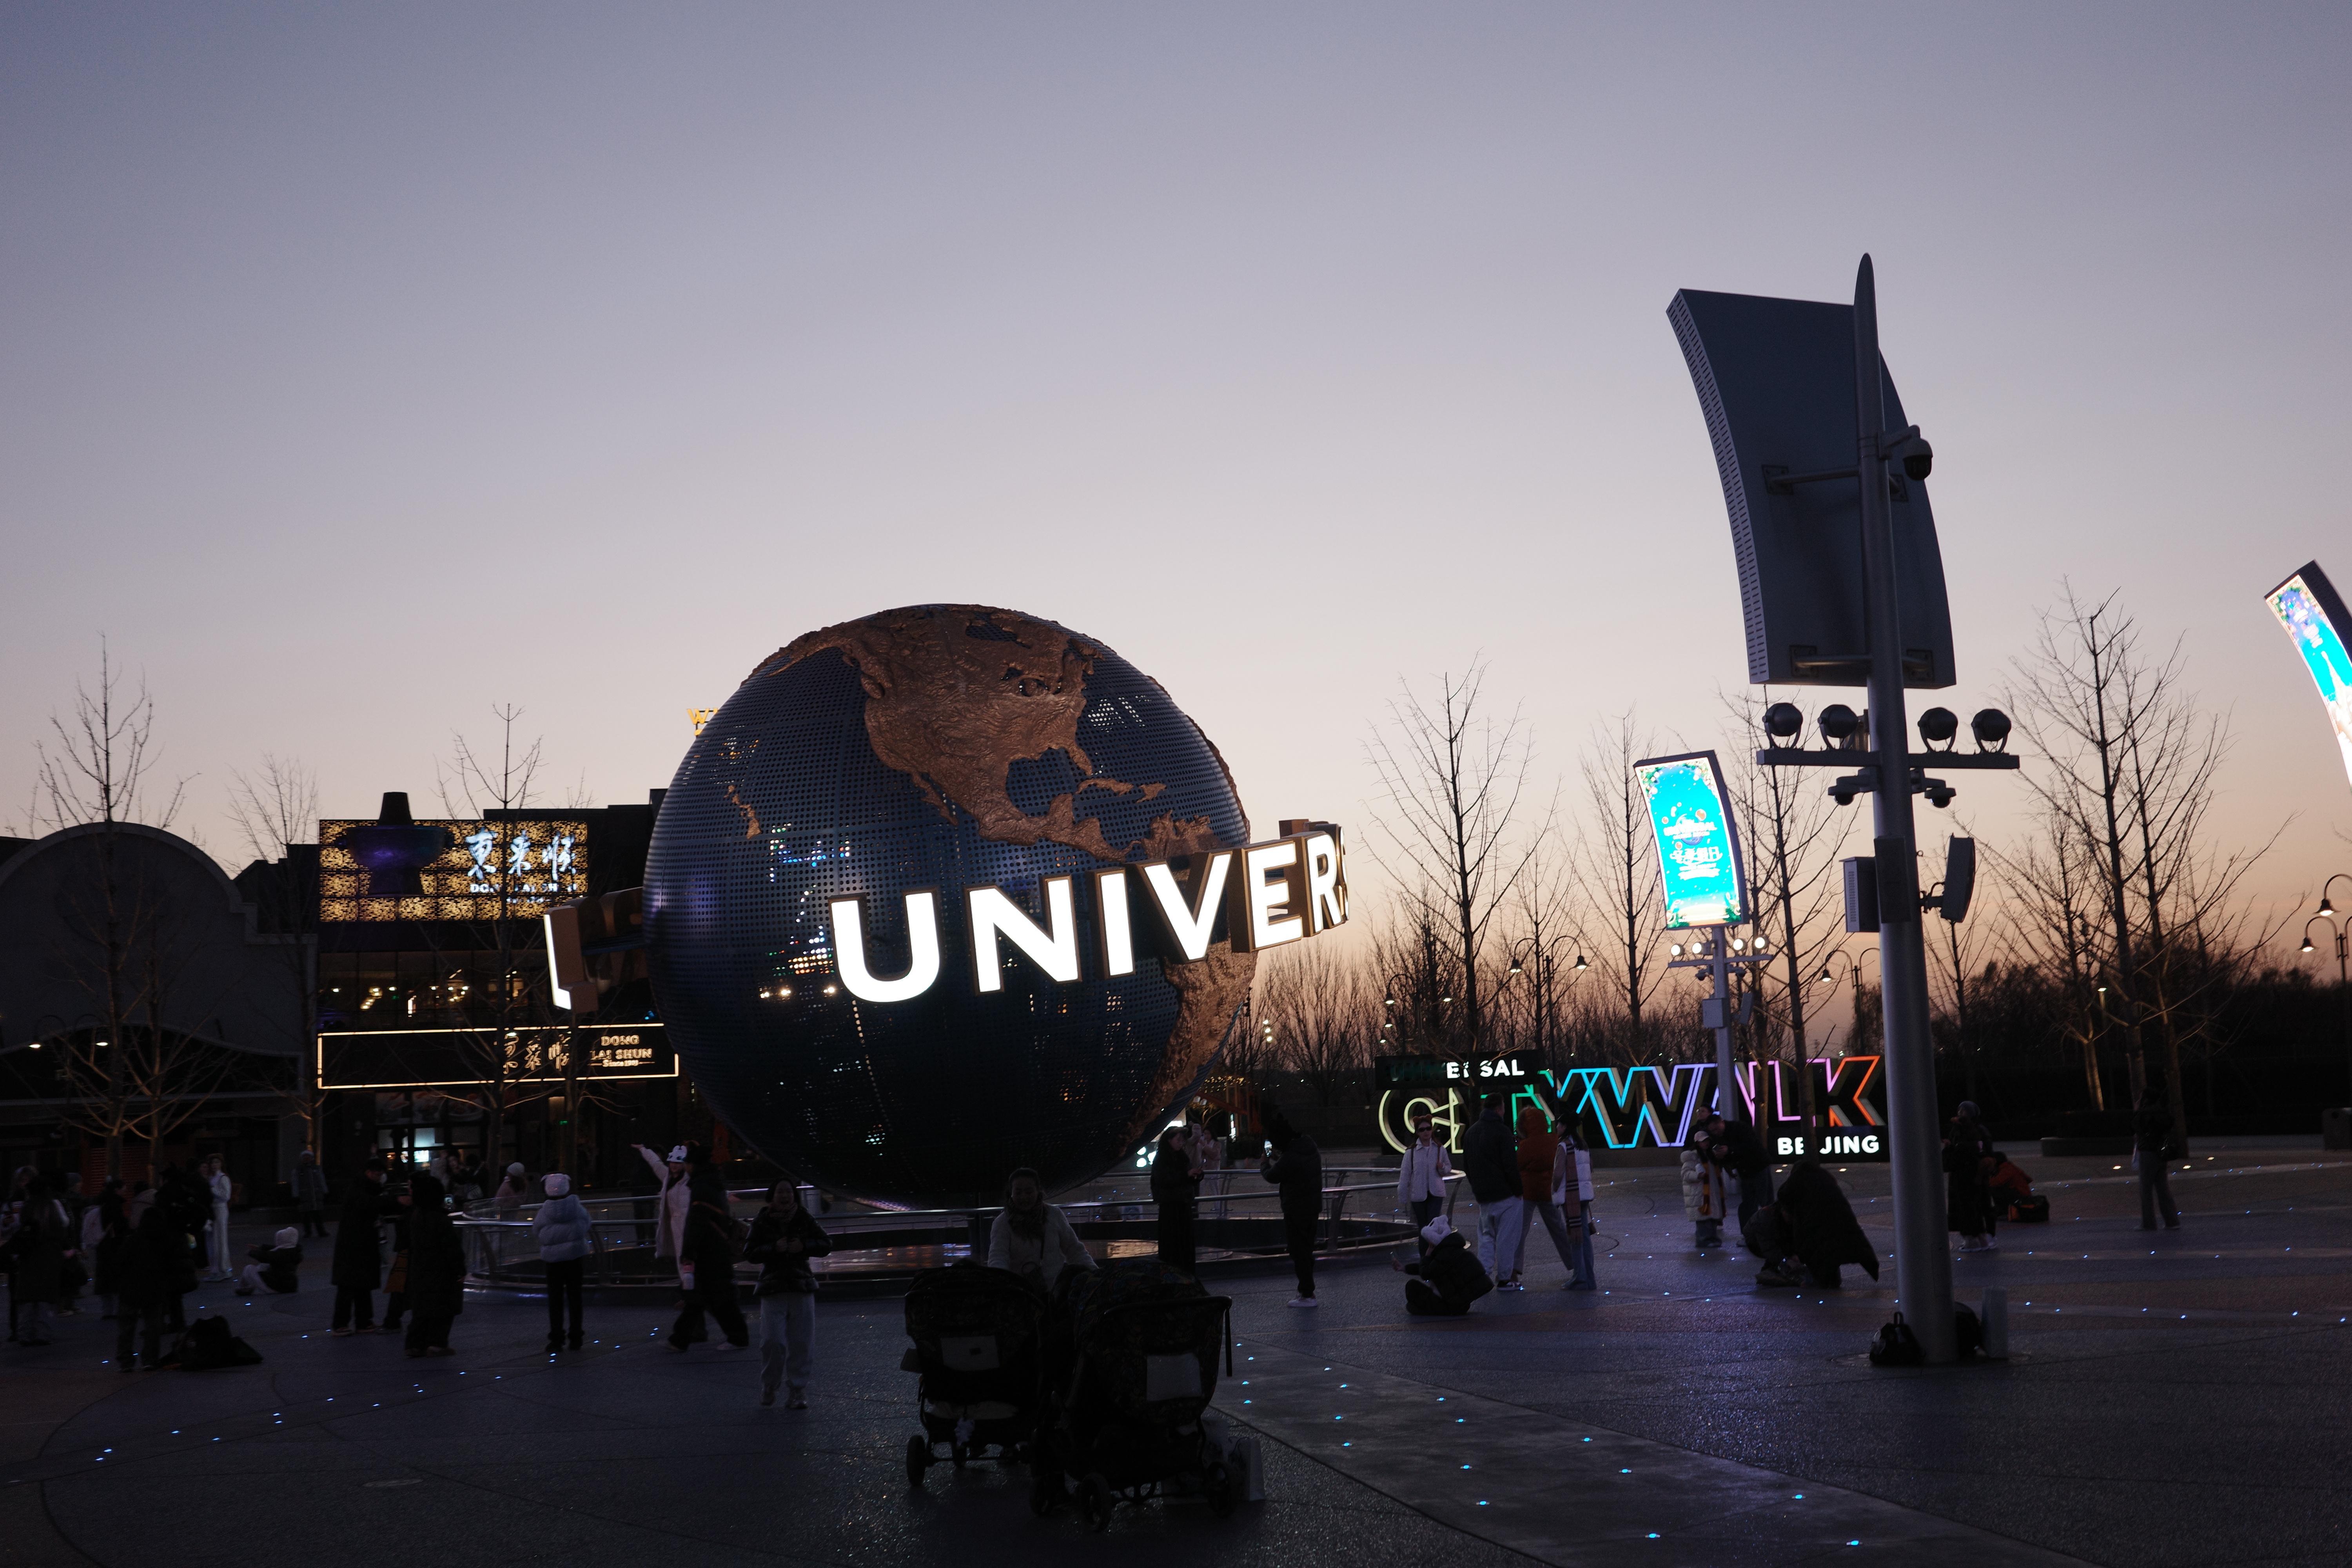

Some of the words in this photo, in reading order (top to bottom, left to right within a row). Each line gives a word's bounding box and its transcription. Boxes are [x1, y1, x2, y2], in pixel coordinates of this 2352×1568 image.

[687, 708, 718, 725] W
[601, 1035, 639, 1046] DONG
[589, 1050, 612, 1060] LAI
[615, 1048, 652, 1059] SHUN
[1777, 1135, 1879, 1155] BEJING
